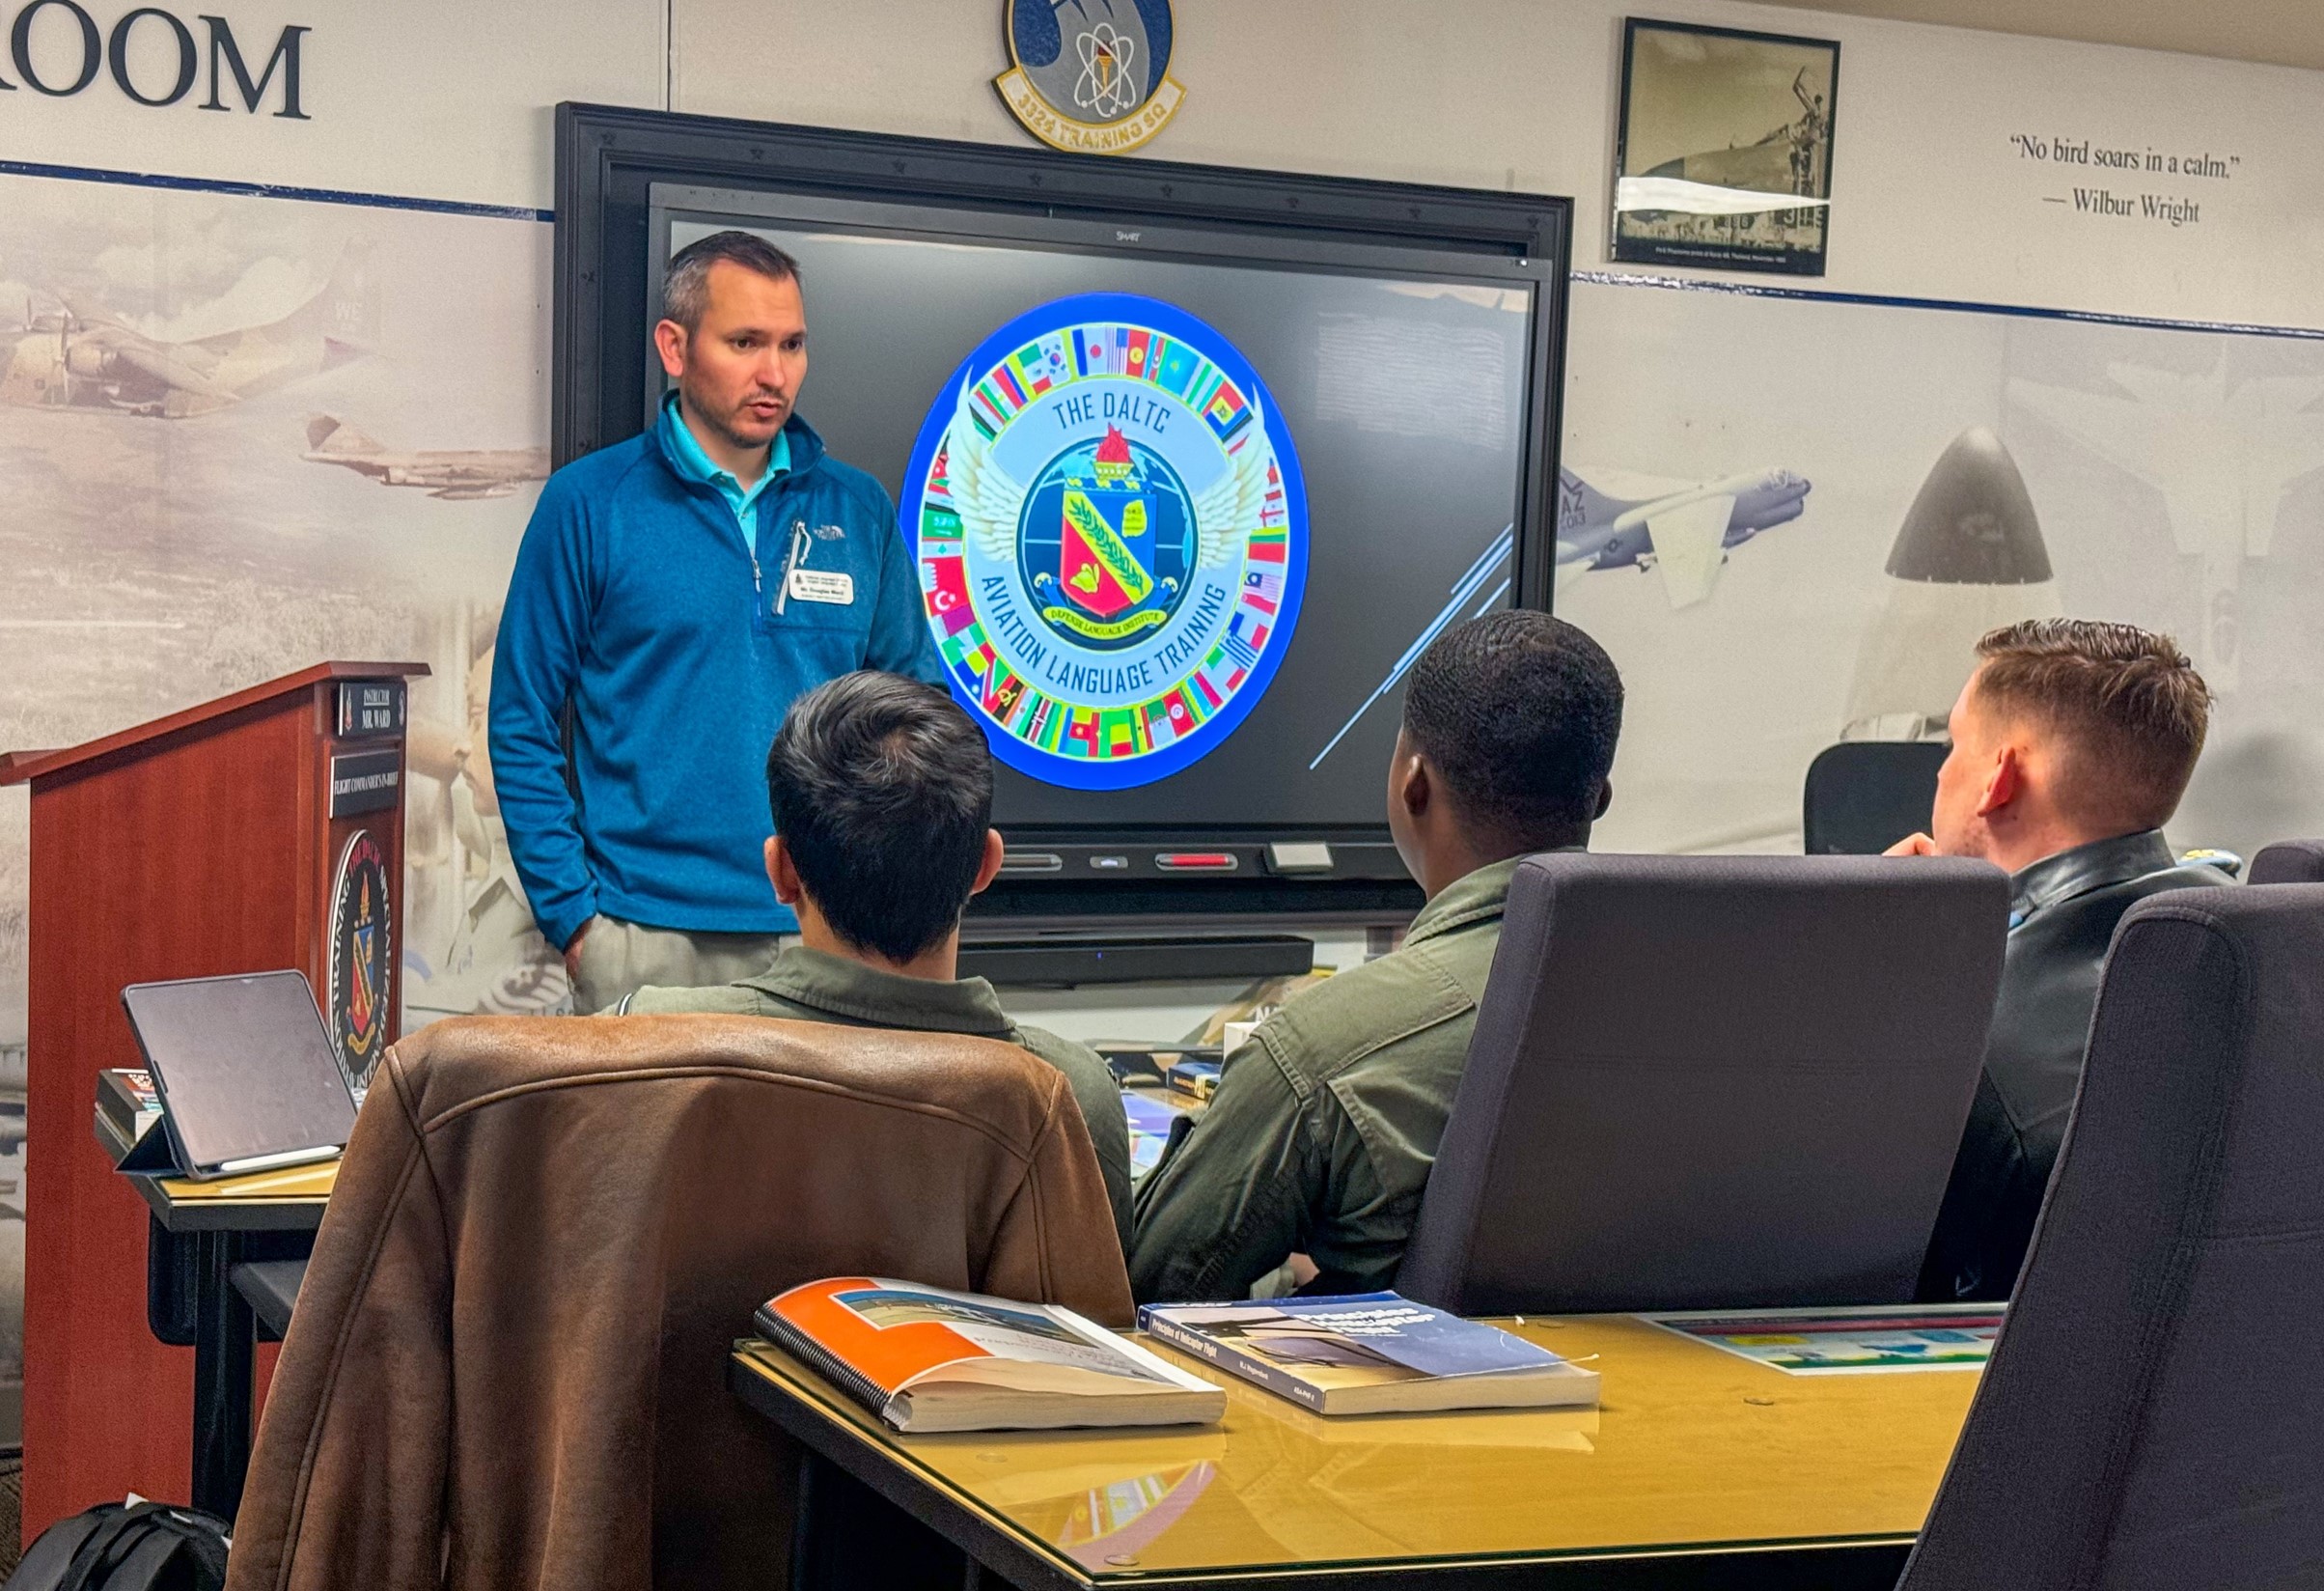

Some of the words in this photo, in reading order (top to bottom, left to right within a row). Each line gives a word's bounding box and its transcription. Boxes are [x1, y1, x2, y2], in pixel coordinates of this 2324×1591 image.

[0, 0, 312, 120] OOM
[1060, 122, 1143, 149] TRAINING
[1143, 102, 1168, 127] SQ
[2053, 137, 2089, 164] bird
[2093, 147, 2140, 170] soars
[2145, 146, 2162, 172] in
[2168, 156, 2177, 174] a
[2073, 187, 2134, 217] Wilbur
[2141, 194, 2200, 228] Wright
[1052, 394, 1095, 430] THE
[1104, 392, 1171, 433] DALTC
[982, 575, 1047, 670] AVIATION
[1046, 655, 1153, 694] LANGUAGE
[1154, 583, 1227, 675] TRAINING
[1051, 609, 1083, 629] DEFENSE
[1084, 625, 1122, 636] LANGUAGE
[1122, 612, 1159, 629] INSTITUTE
[374, 709, 391, 729] WARD
[335, 778, 350, 796] FLIGHT
[333, 873, 350, 1008] TRAINING
[1152, 1318, 1175, 1338] Principles
[1204, 1342, 1218, 1358] Flight
